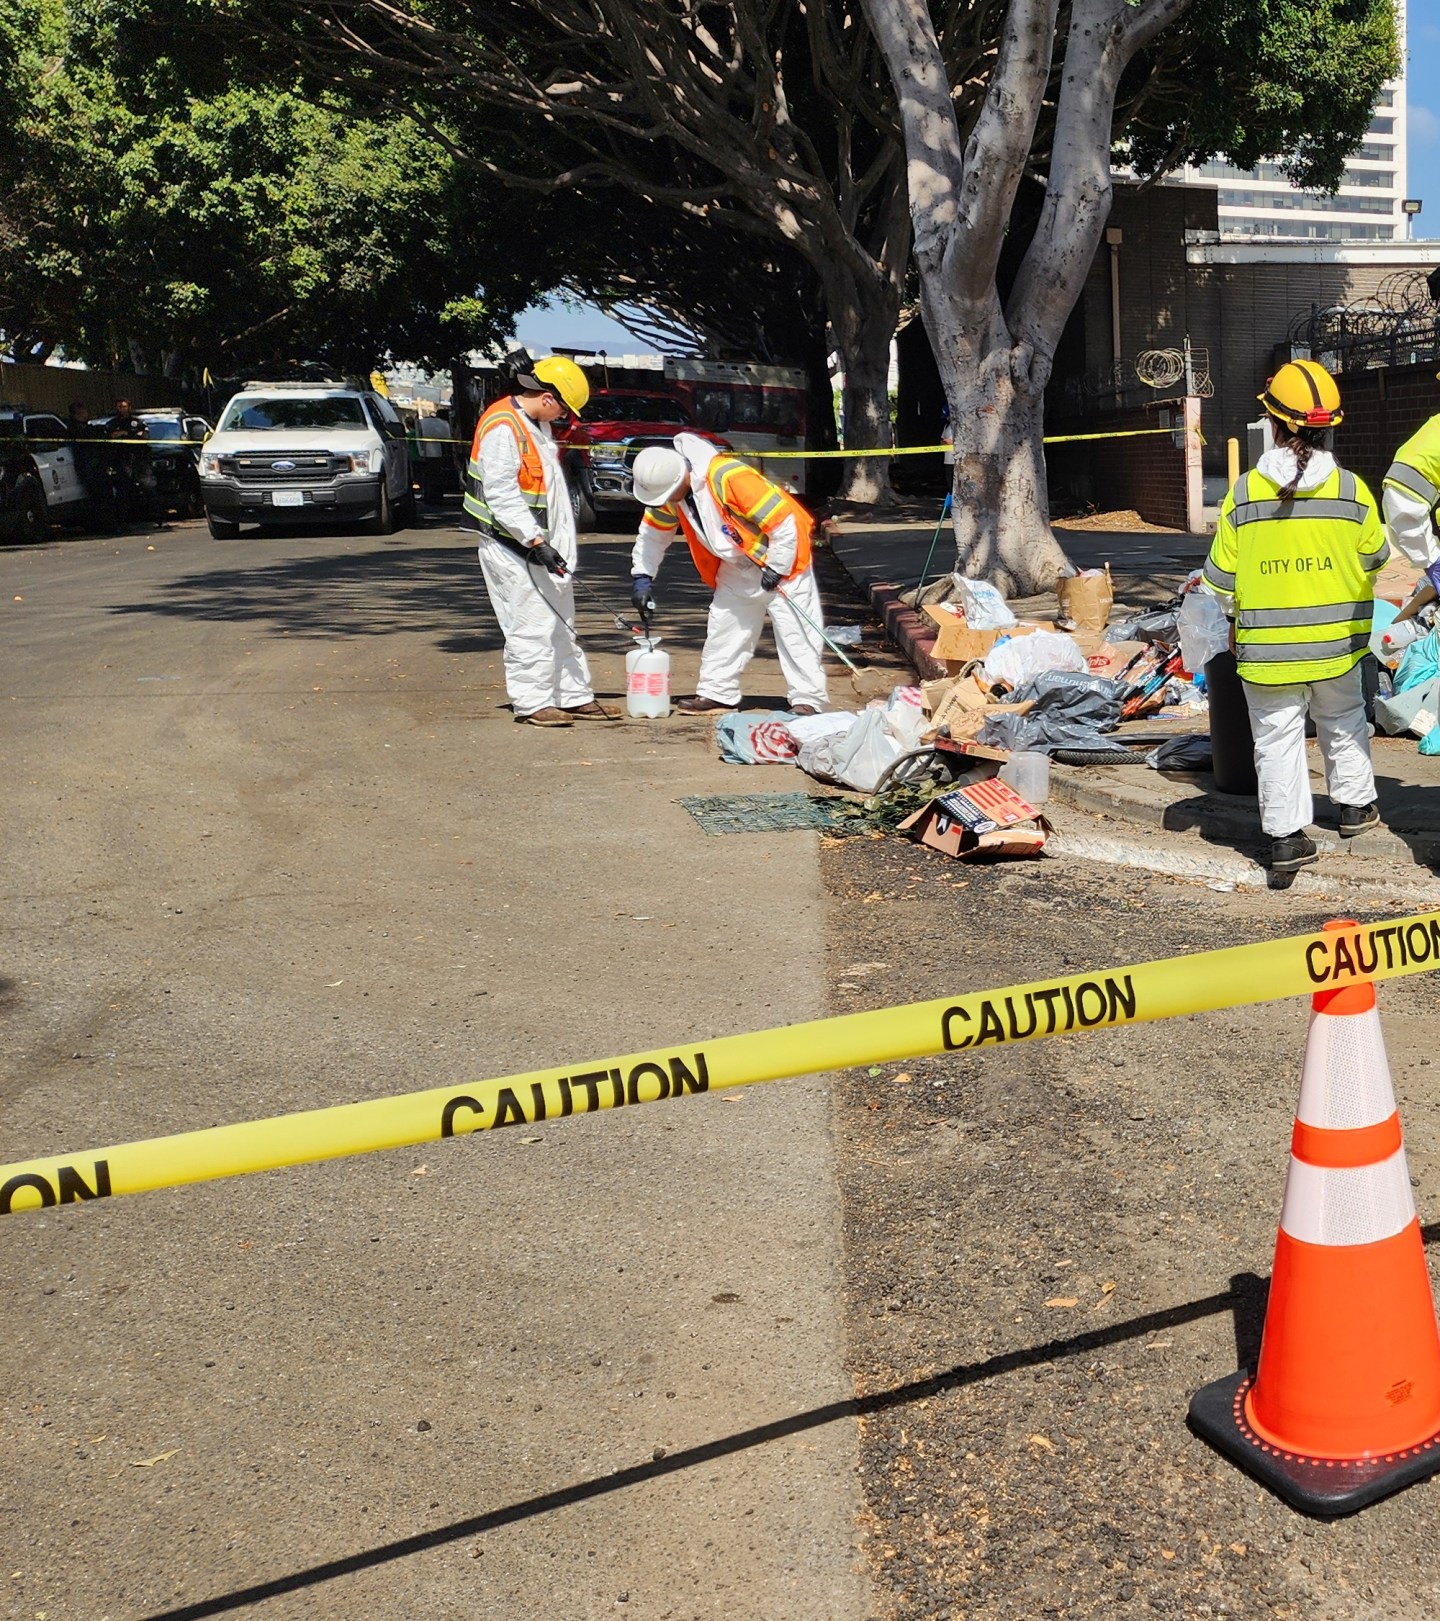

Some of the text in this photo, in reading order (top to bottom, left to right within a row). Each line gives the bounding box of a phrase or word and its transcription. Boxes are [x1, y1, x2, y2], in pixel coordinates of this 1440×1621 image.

[1260, 556, 1333, 575] CITY OF LA
[0, 1160, 112, 1214] ON
[440, 1052, 709, 1138] CAUTION
[940, 974, 1137, 1052] CAUTION
